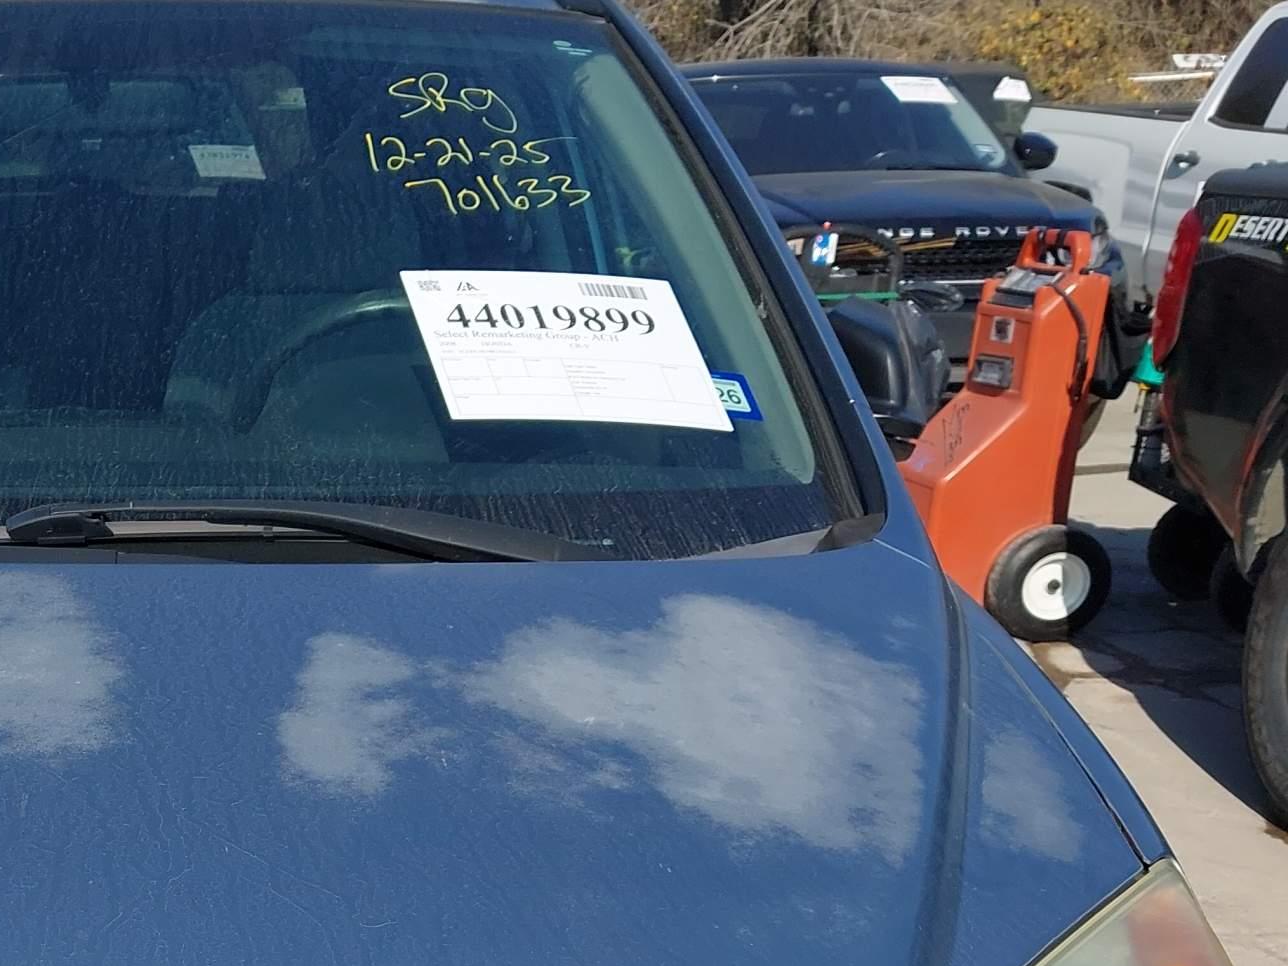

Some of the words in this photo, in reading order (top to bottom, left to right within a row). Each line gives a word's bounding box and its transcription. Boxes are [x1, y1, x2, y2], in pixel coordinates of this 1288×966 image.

[365, 132, 578, 172] 12-21-25
[404, 175, 591, 215] 701633
[446, 303, 656, 335] 44019899
